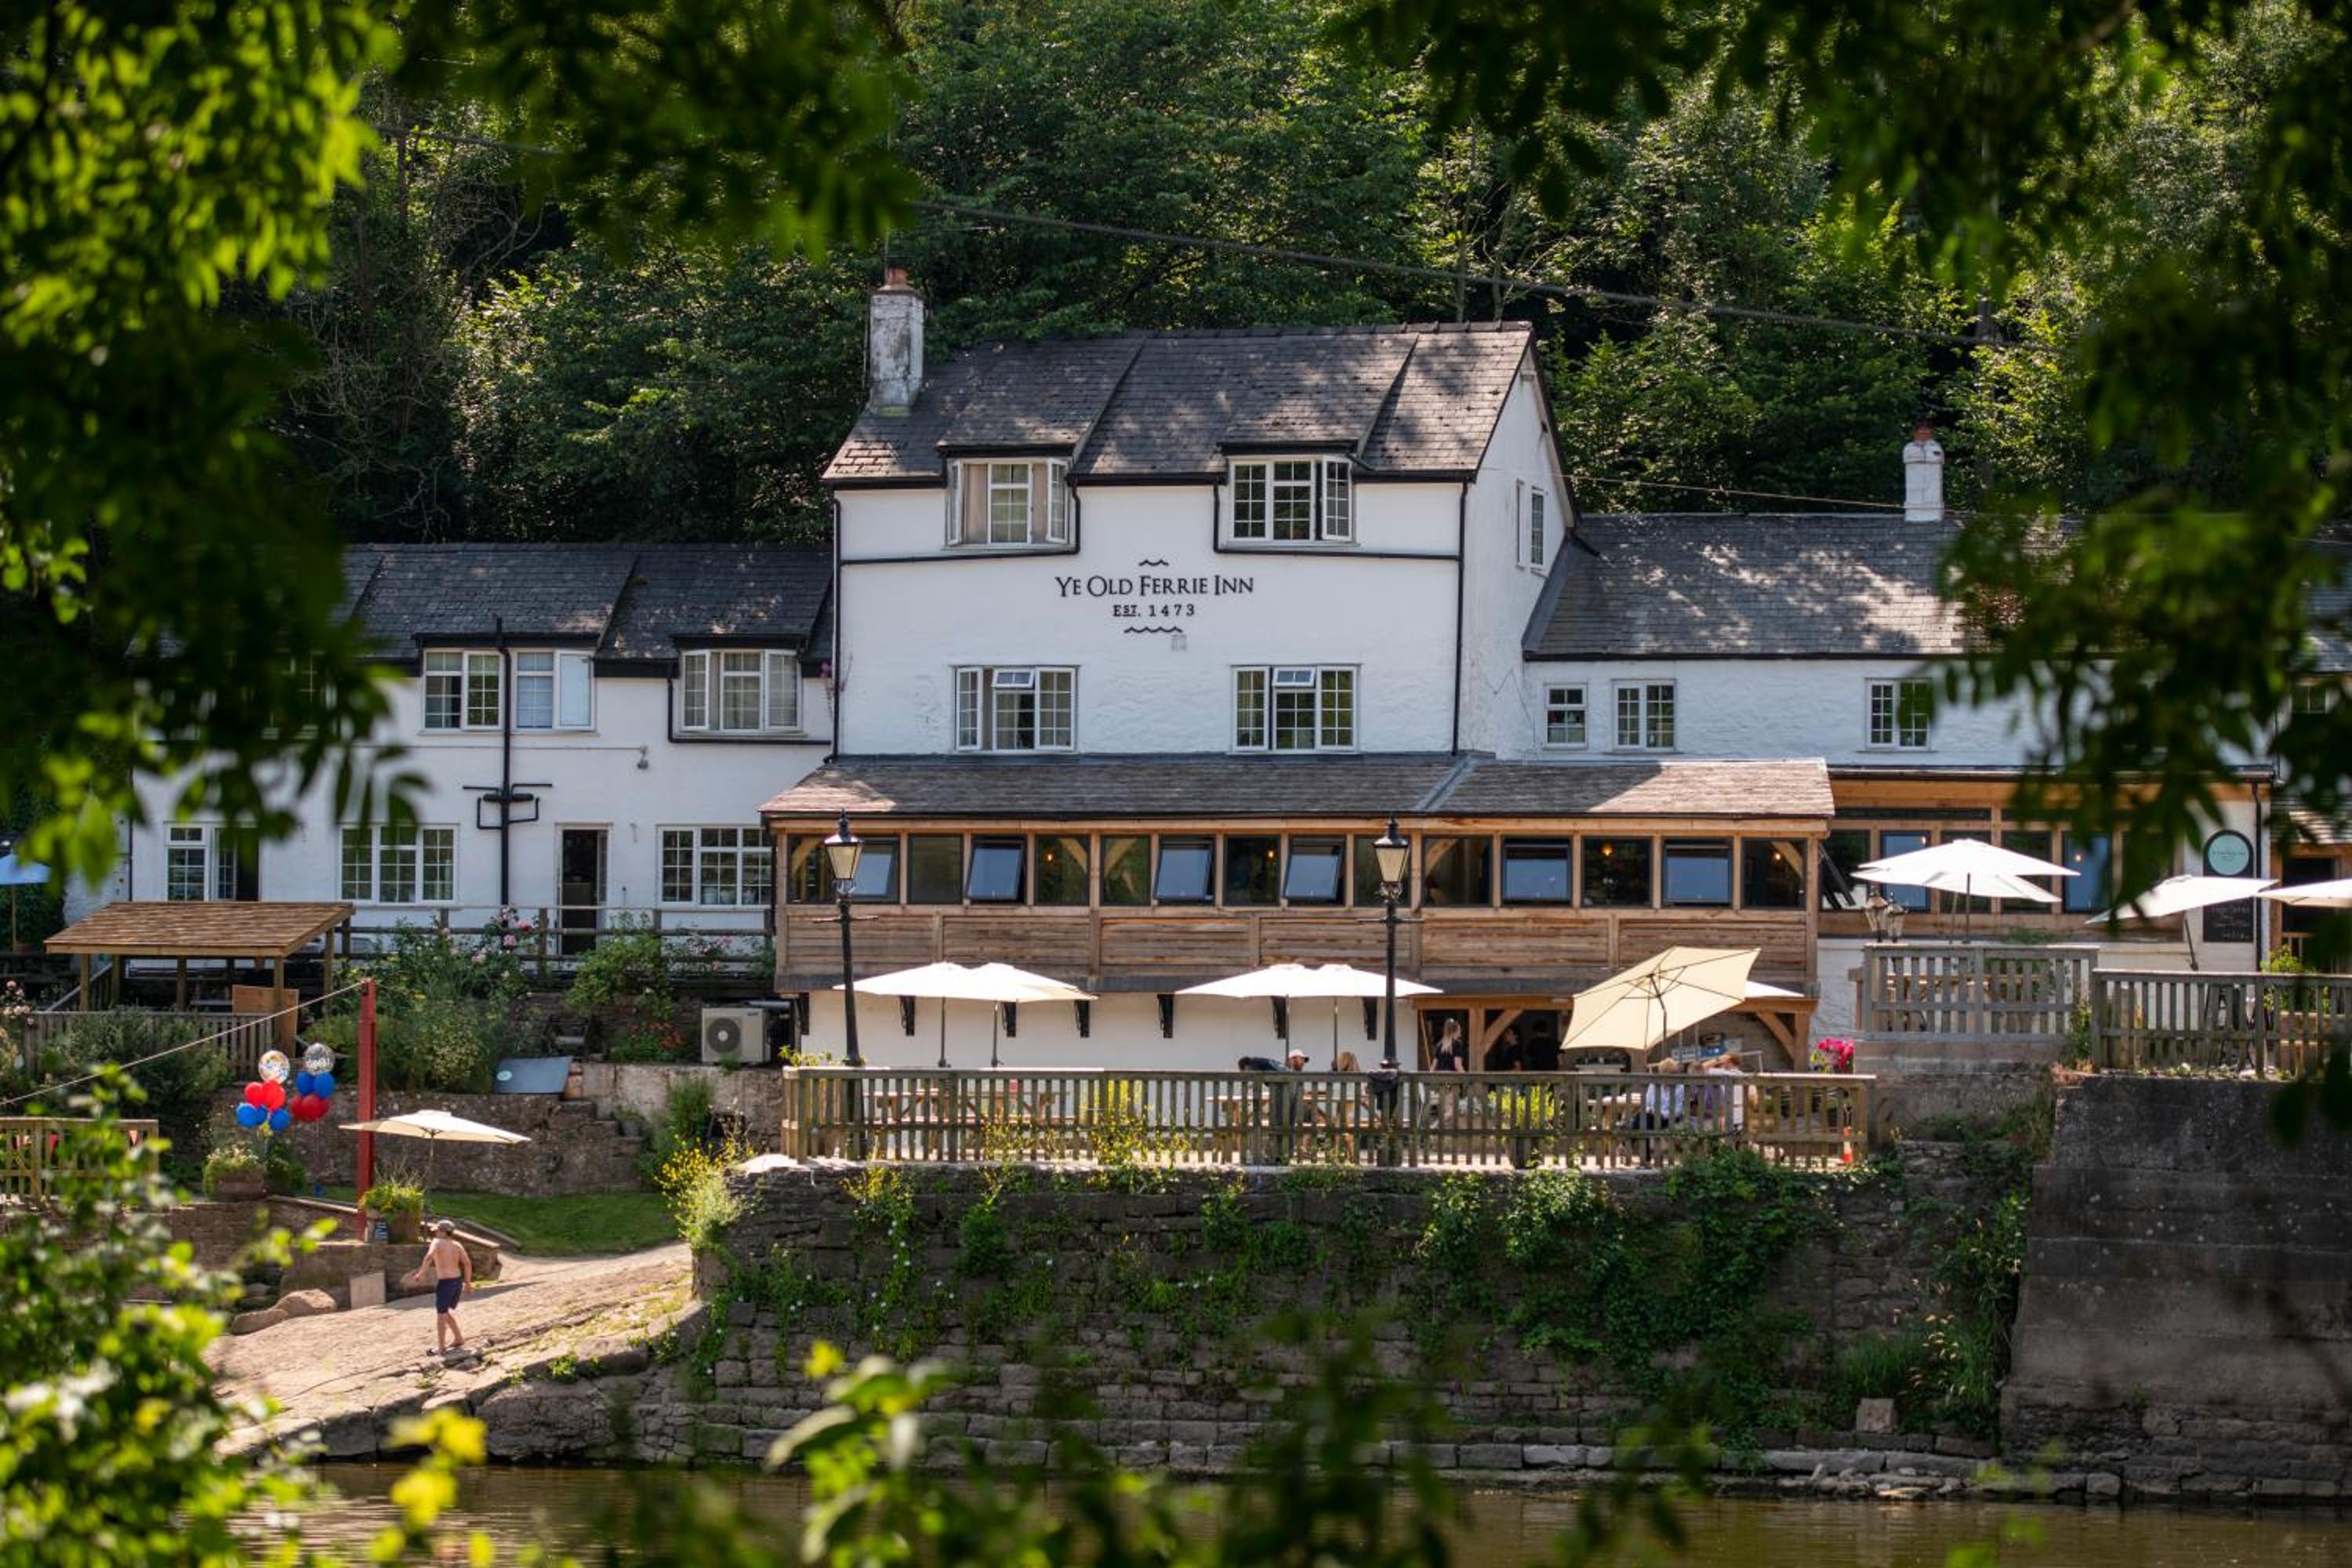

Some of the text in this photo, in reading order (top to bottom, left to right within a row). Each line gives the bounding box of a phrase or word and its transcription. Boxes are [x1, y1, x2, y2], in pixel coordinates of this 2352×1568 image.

[1054, 575, 1254, 597] YE OLD FERRIE INN
[1149, 604, 1195, 617] 1473
